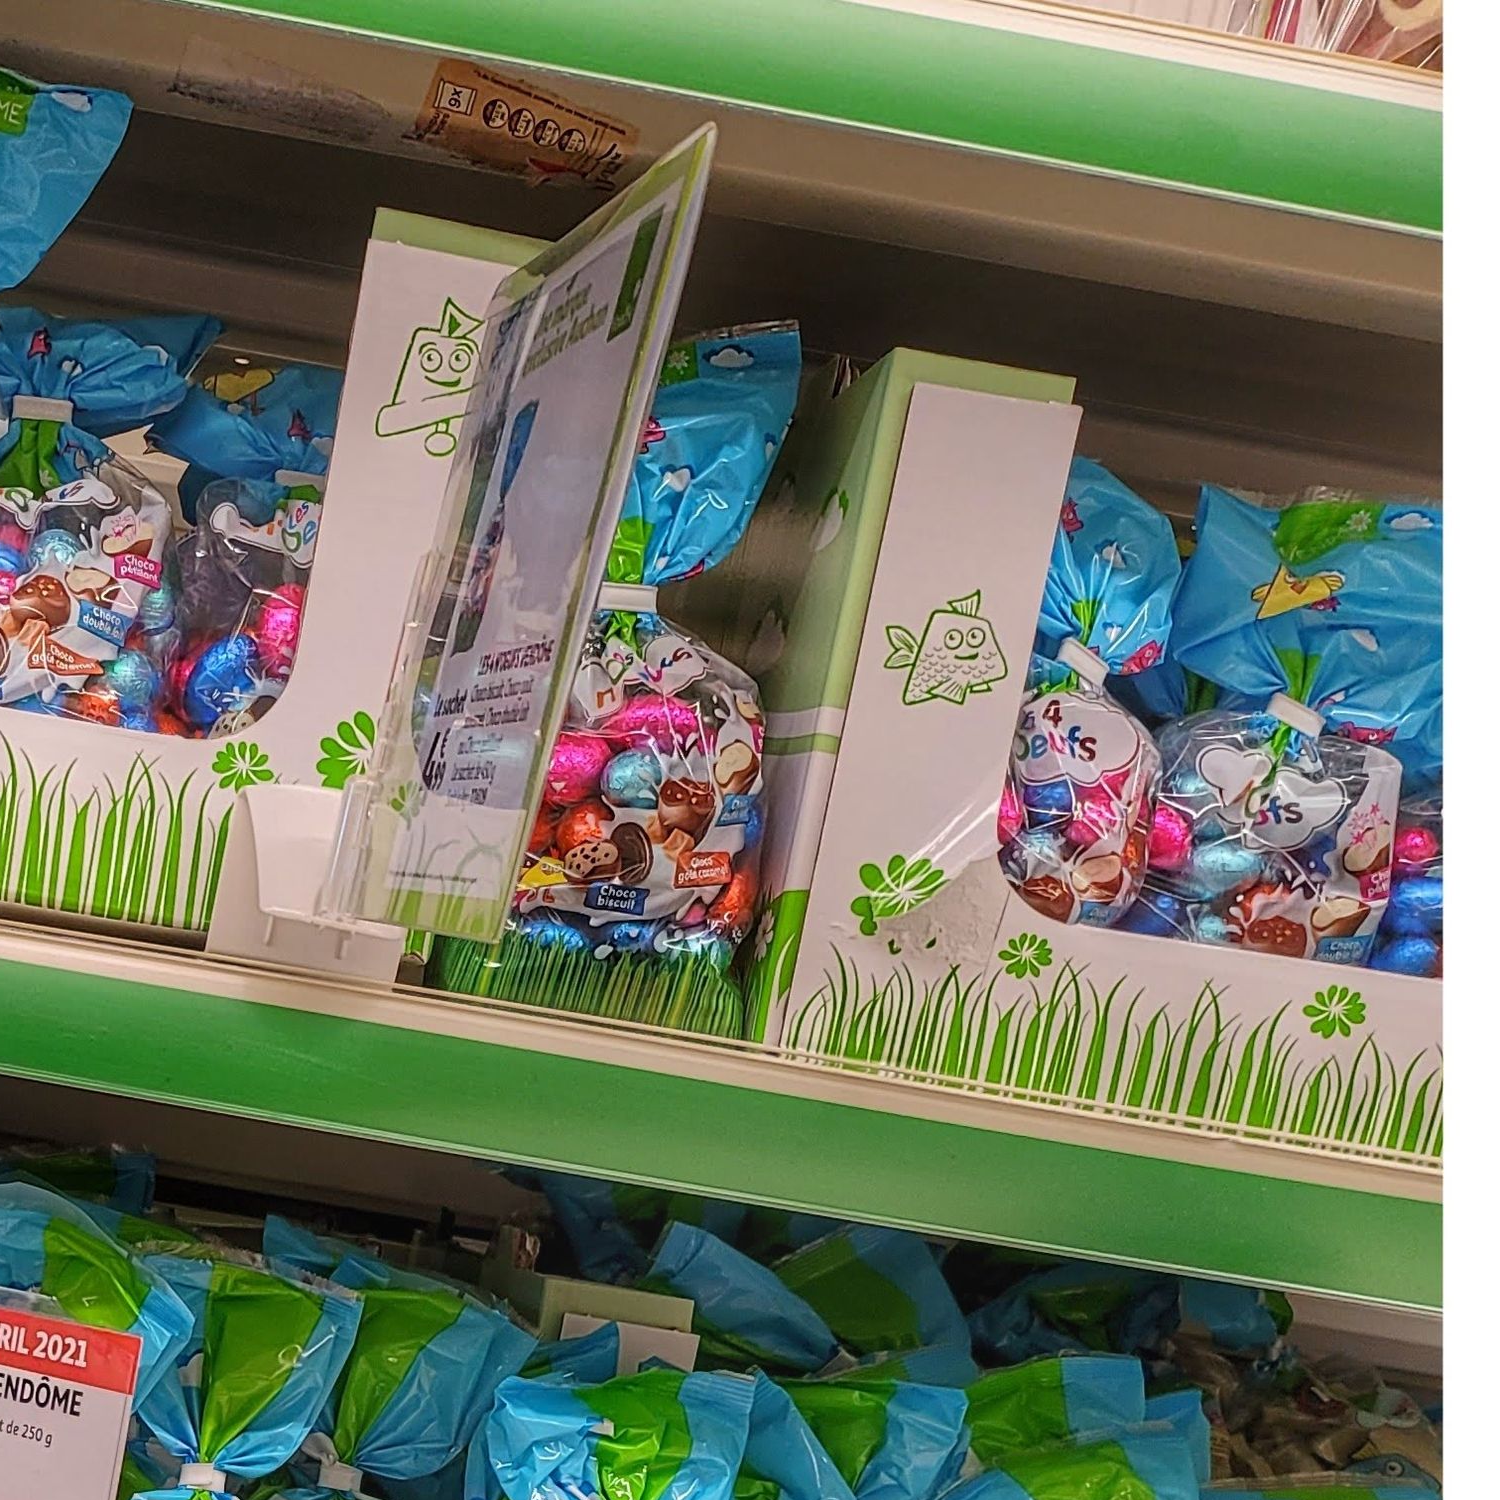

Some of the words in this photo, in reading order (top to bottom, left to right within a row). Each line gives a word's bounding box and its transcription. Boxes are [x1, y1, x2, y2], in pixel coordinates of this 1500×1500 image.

[124, 555, 155, 573] Choco
[1042, 700, 1063, 728] 4
[599, 884, 638, 899] Choco
[596, 896, 636, 911] biscuit
[27, 1332, 89, 1369] 2021
[5, 1419, 21, 1437] de
[20, 1424, 44, 1444] 250
[44, 1432, 54, 1448] g
